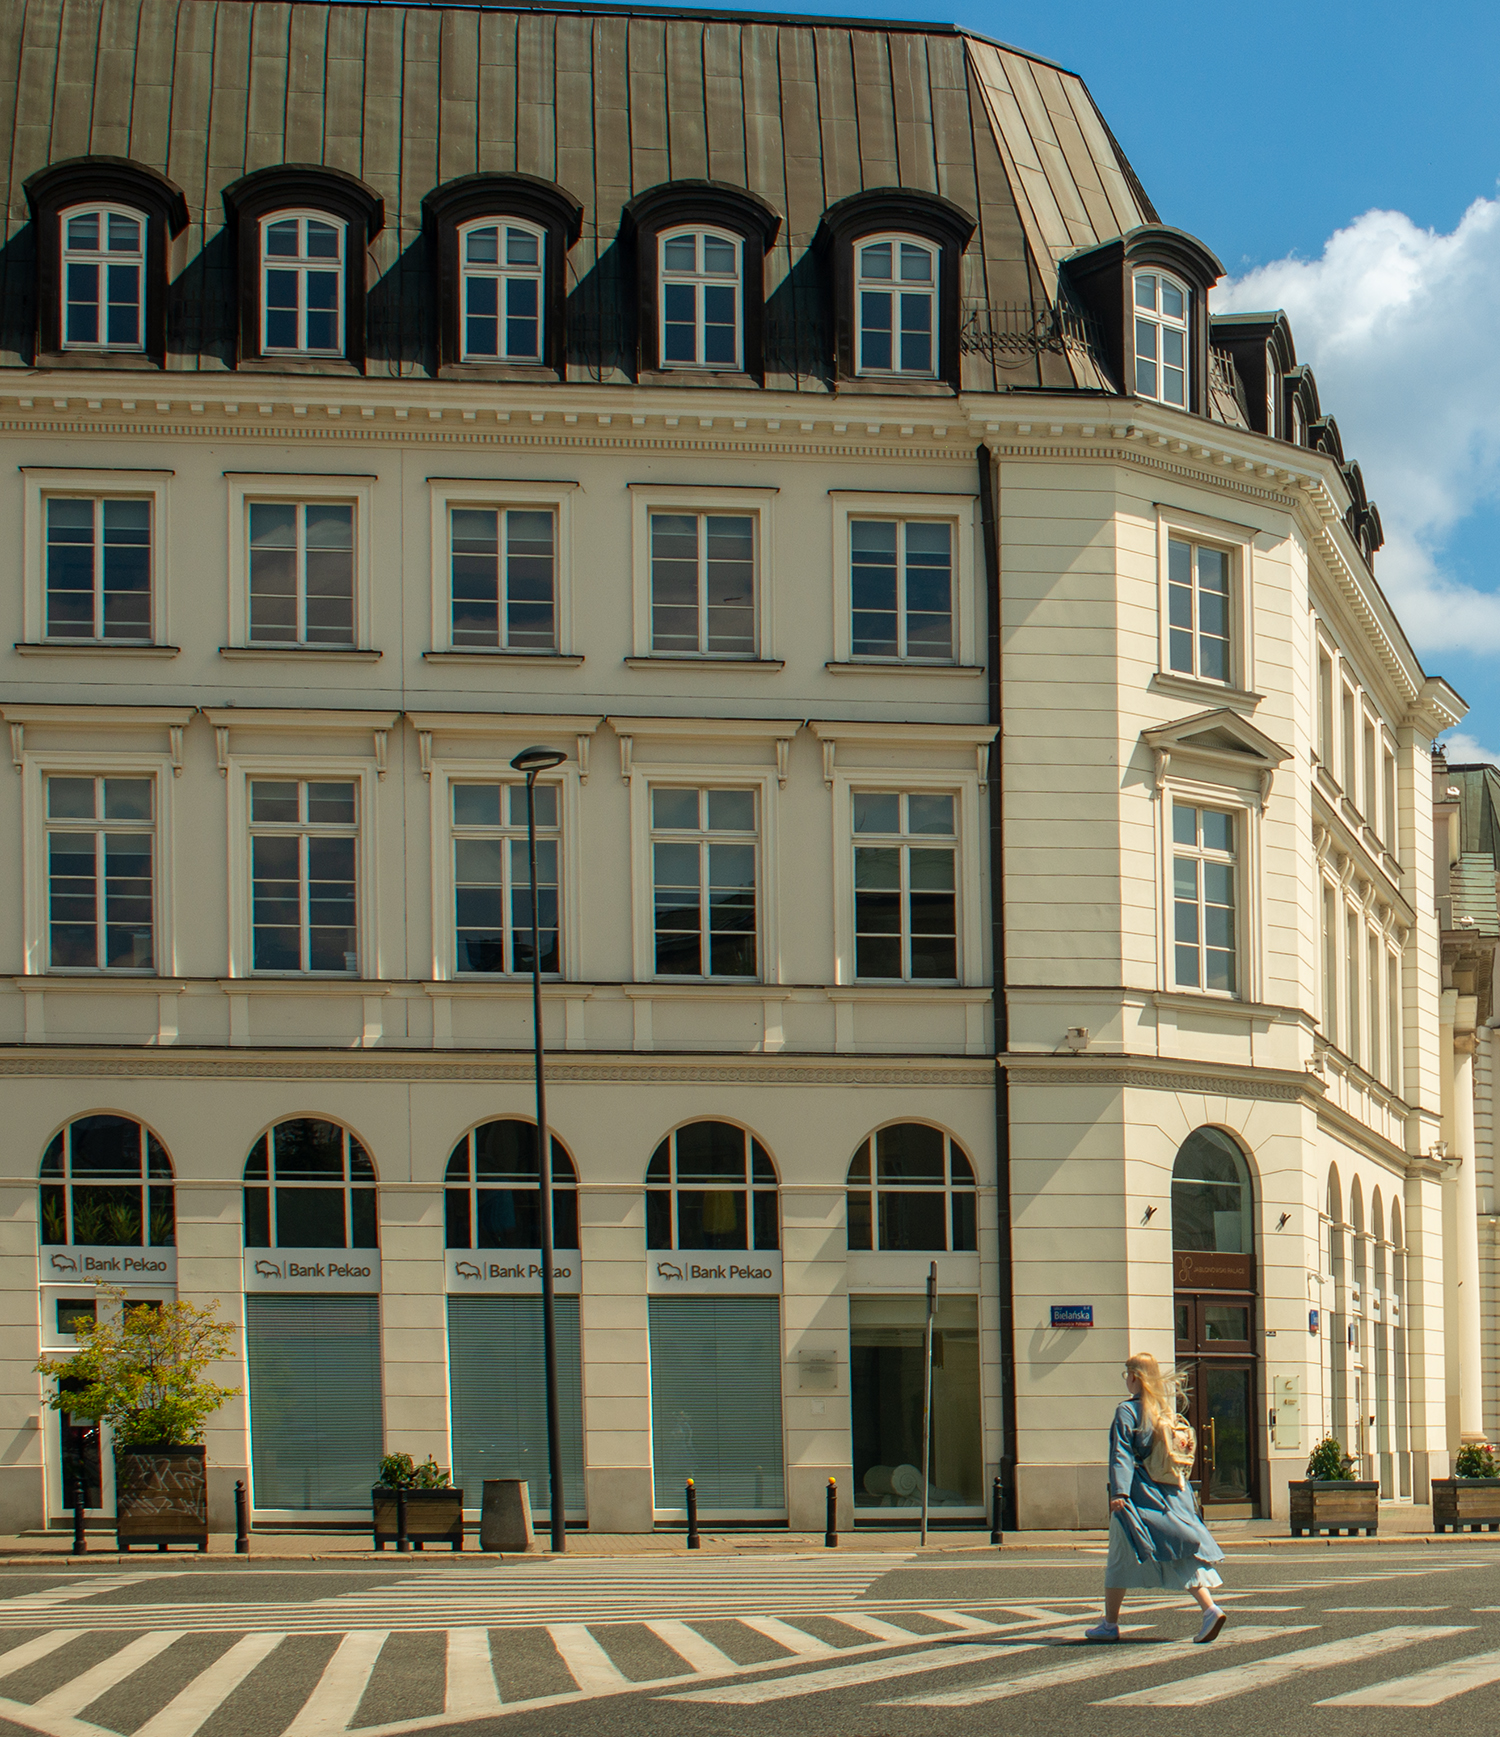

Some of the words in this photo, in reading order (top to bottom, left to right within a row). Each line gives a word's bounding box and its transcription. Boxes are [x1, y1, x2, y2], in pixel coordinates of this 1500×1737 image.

[85, 1257, 121, 1271] Bank
[124, 1257, 167, 1272] Pekao
[289, 1262, 325, 1277] Bank
[328, 1263, 371, 1277] Pekao
[490, 1264, 526, 1278] Bank
[529, 1264, 572, 1278] Peao
[691, 1265, 727, 1279] Bank
[730, 1265, 772, 1279] Pekao
[1054, 1310, 1090, 1320] Bielańska
